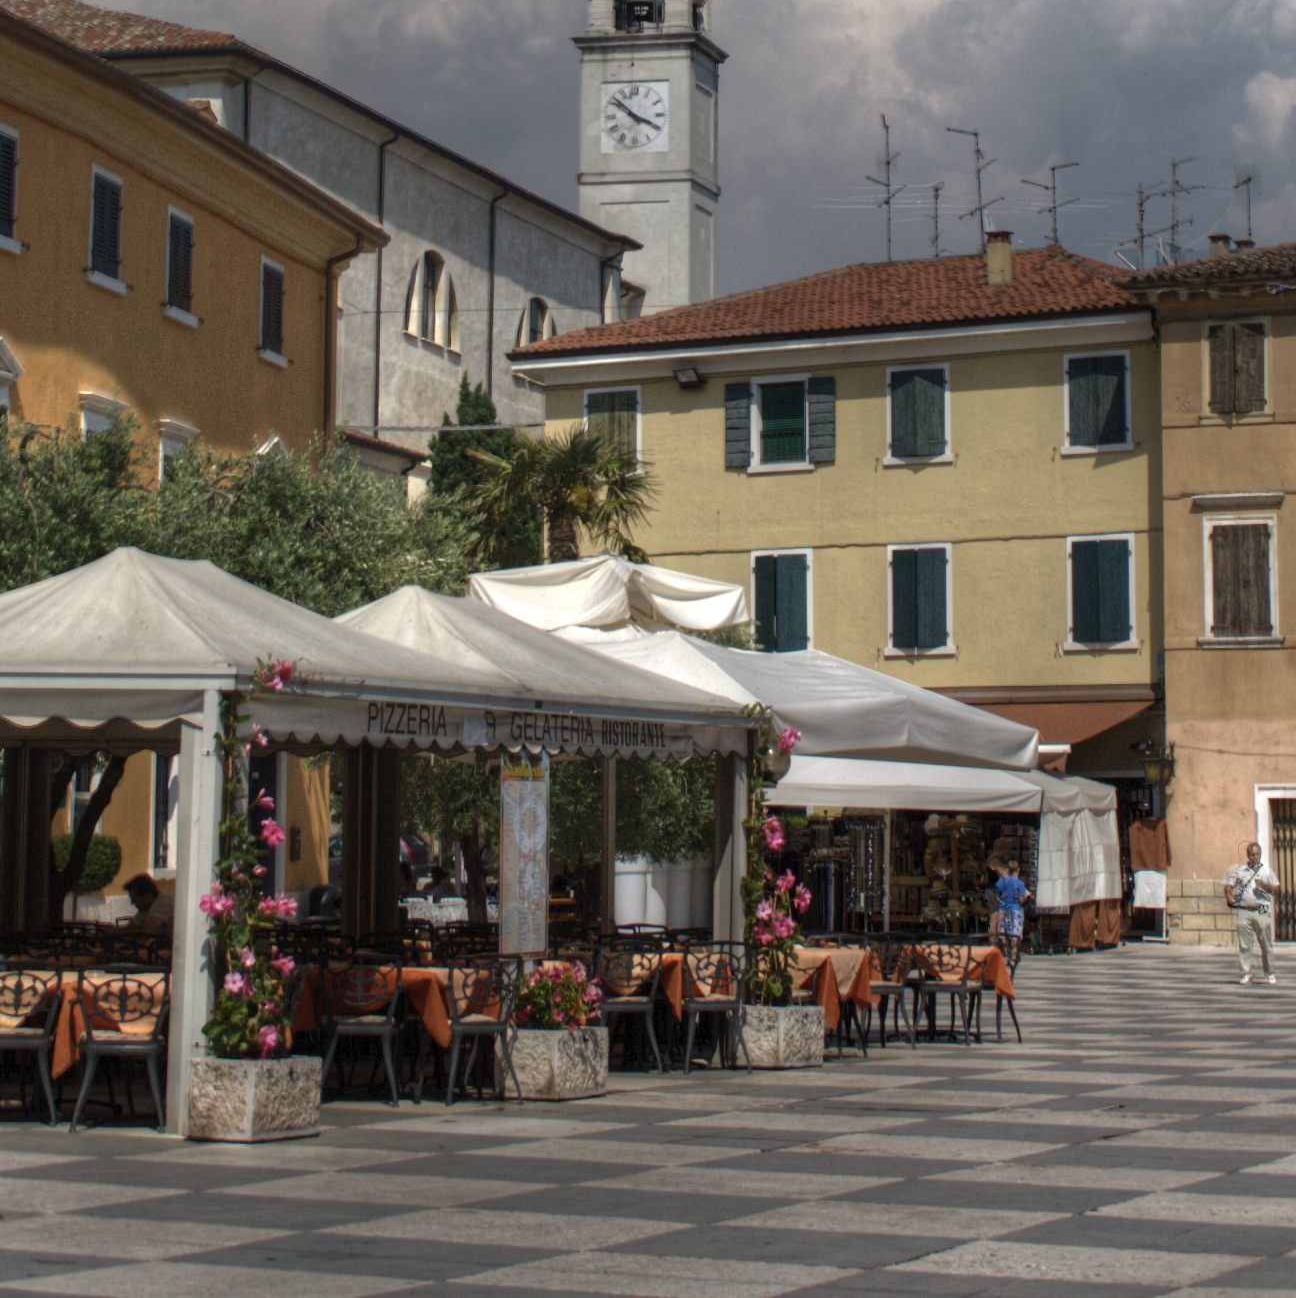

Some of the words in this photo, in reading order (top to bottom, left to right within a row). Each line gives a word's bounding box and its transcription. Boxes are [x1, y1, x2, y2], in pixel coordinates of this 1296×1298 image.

[367, 702, 447, 736] PIZZERIA
[510, 711, 595, 744] GELATERIA
[601, 719, 666, 748] RISTORANTE
